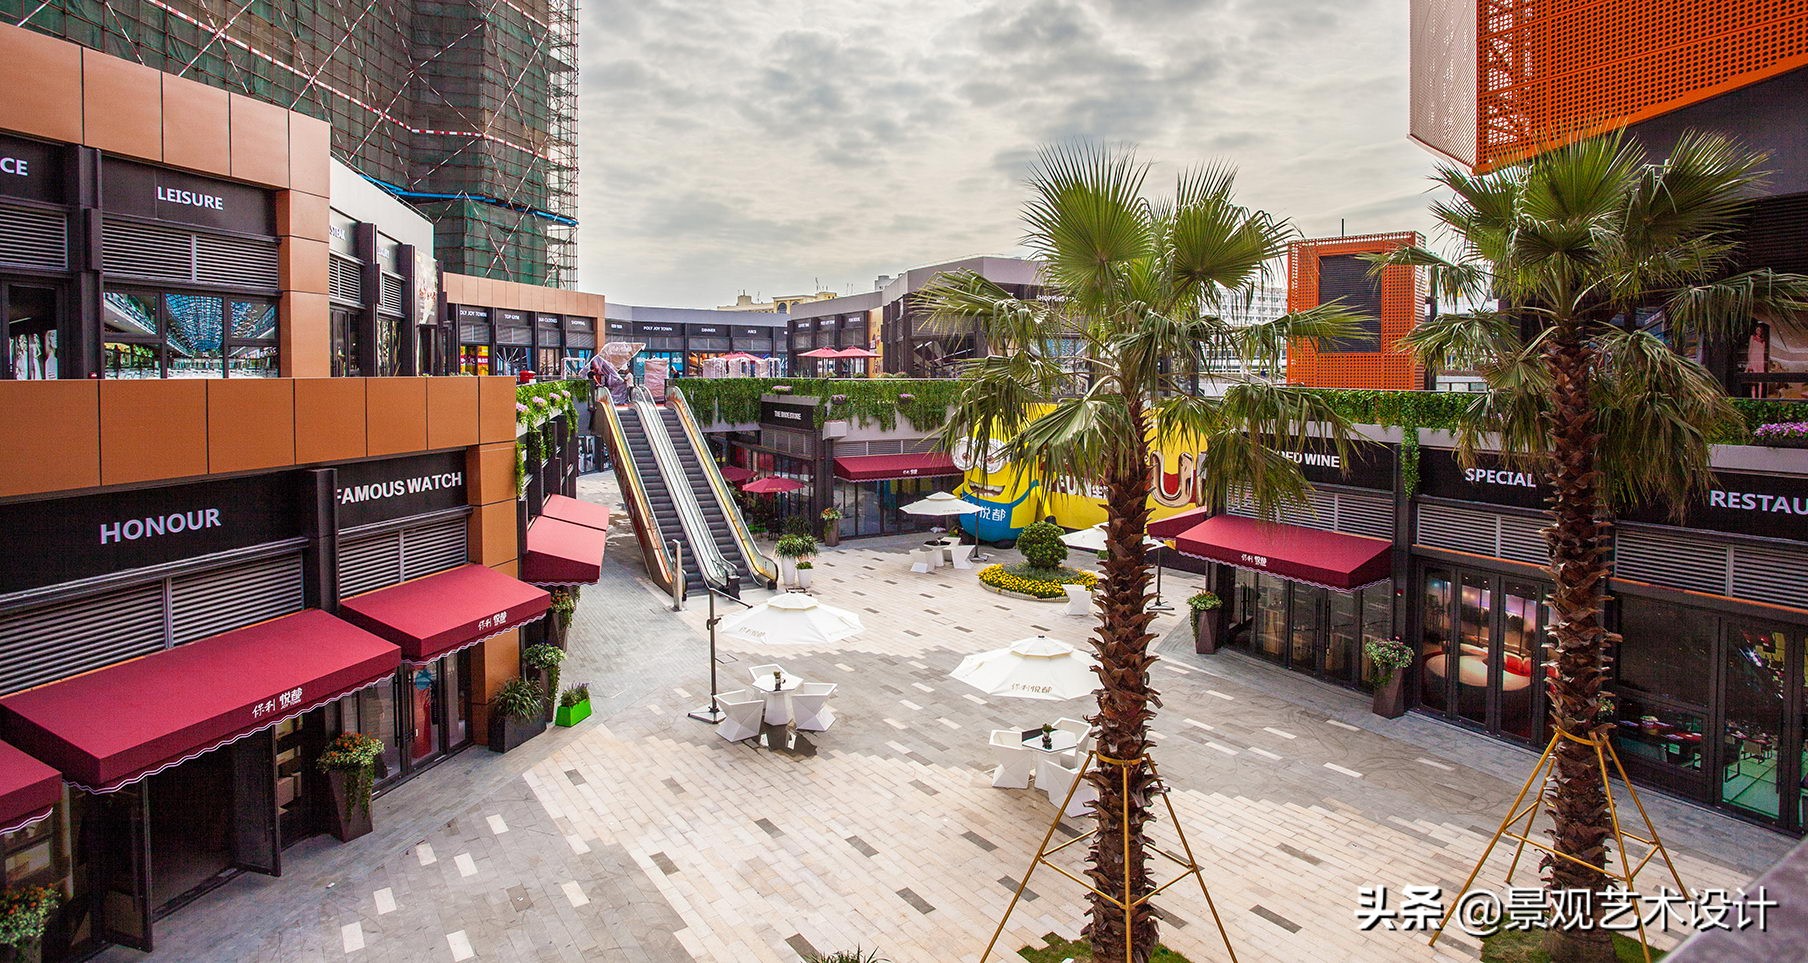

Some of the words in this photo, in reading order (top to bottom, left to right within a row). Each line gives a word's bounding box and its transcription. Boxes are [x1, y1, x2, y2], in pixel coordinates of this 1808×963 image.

[0, 157, 28, 177] CE
[157, 186, 224, 210] LEISURE
[1304, 452, 1340, 468] WINE
[406, 471, 462, 494] WATCH
[1464, 467, 1536, 488] SPECIAL
[100, 507, 222, 545] HONOUR
[252, 698, 276, 718] 保利
